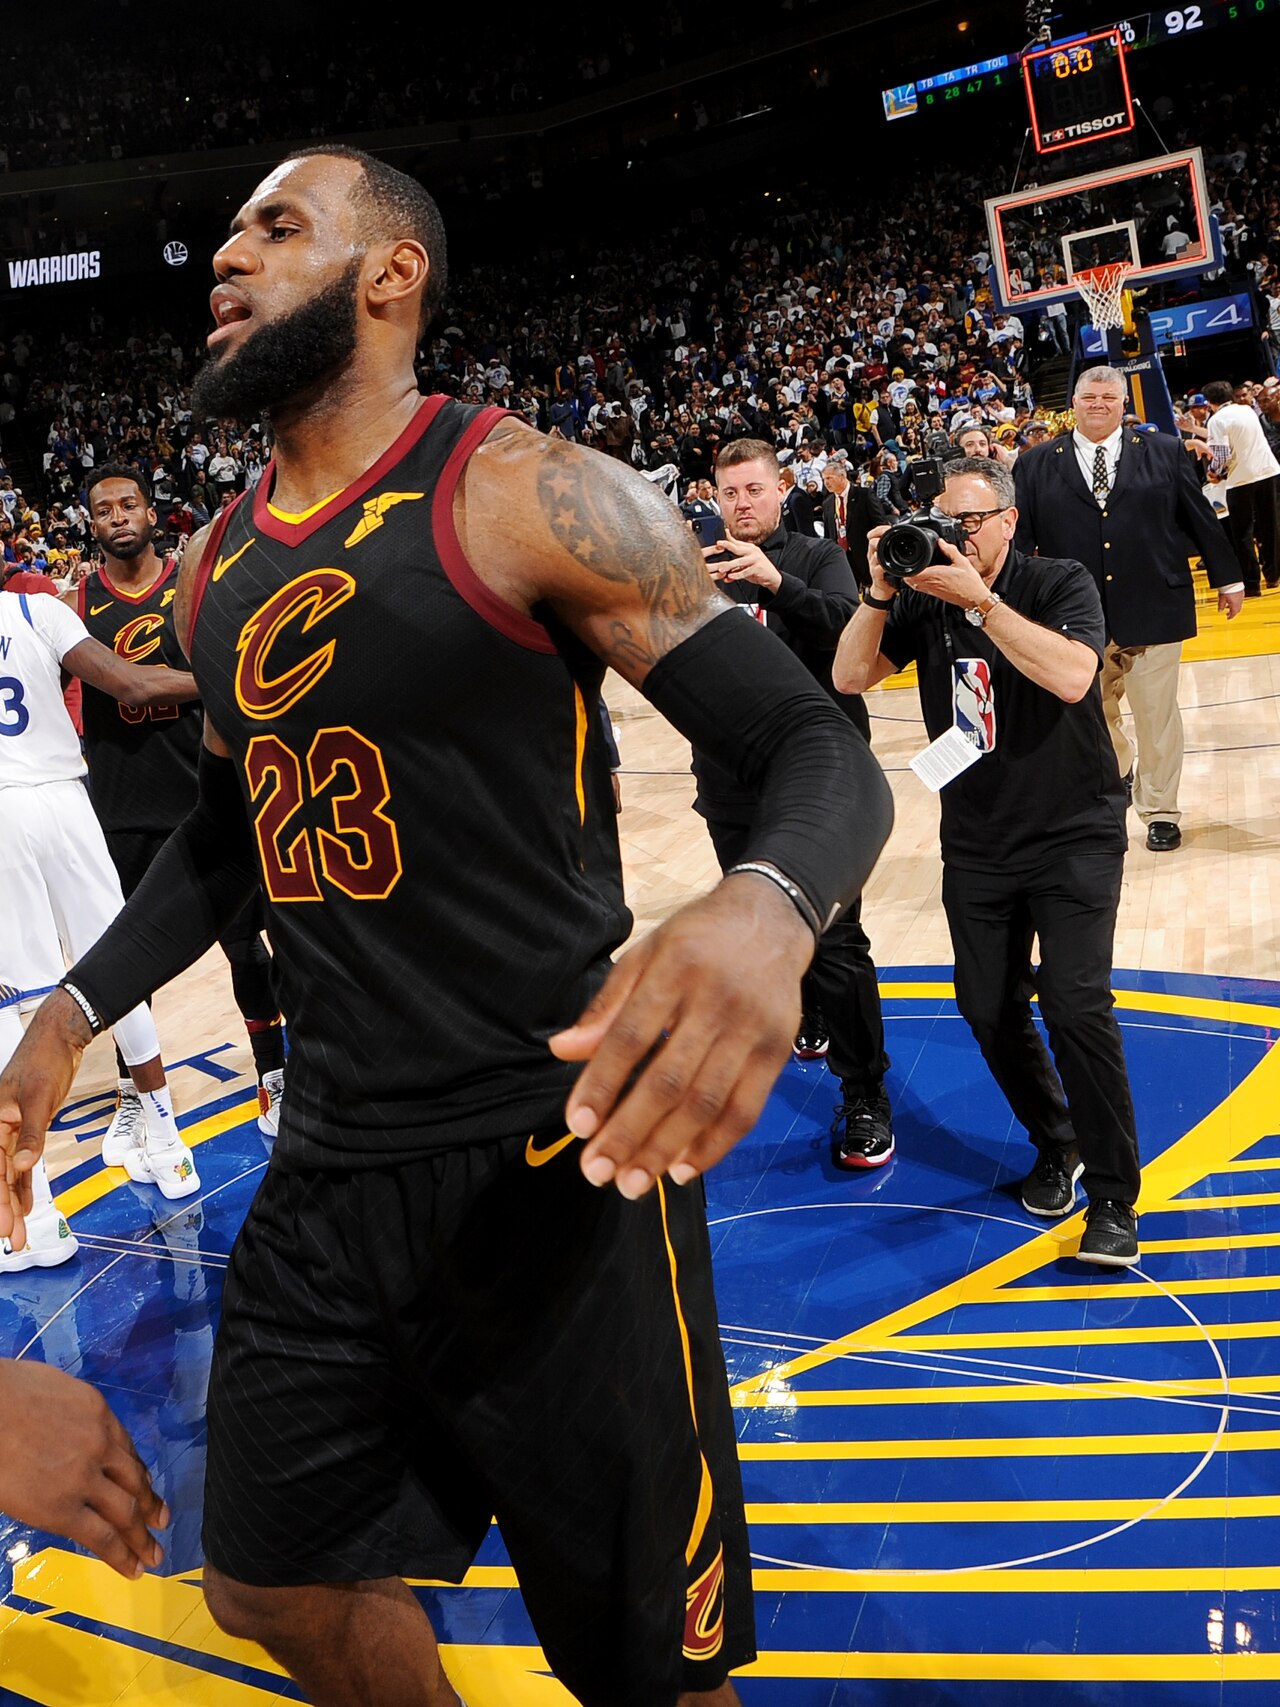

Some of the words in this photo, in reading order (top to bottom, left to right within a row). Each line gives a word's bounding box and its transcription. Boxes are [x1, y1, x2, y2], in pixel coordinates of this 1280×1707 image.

[1165, 5, 1204, 34] 92
[1228, 6, 1238, 19] 5
[1255, 0, 1265, 11] 0
[1113, 20, 1131, 32] th
[921, 79, 934, 89] TB
[944, 72, 955, 82] TA
[965, 64, 978, 76] TR
[986, 59, 1004, 71] TOL
[1054, 48, 1094, 79] 0.0
[926, 94, 934, 104] 8
[945, 86, 960, 100] 28
[966, 80, 983, 93] 47
[994, 74, 1002, 86] 1
[1064, 112, 1126, 138] TISSOT
[8, 250, 101, 289] WARRIORS
[244, 725, 403, 902] 23
